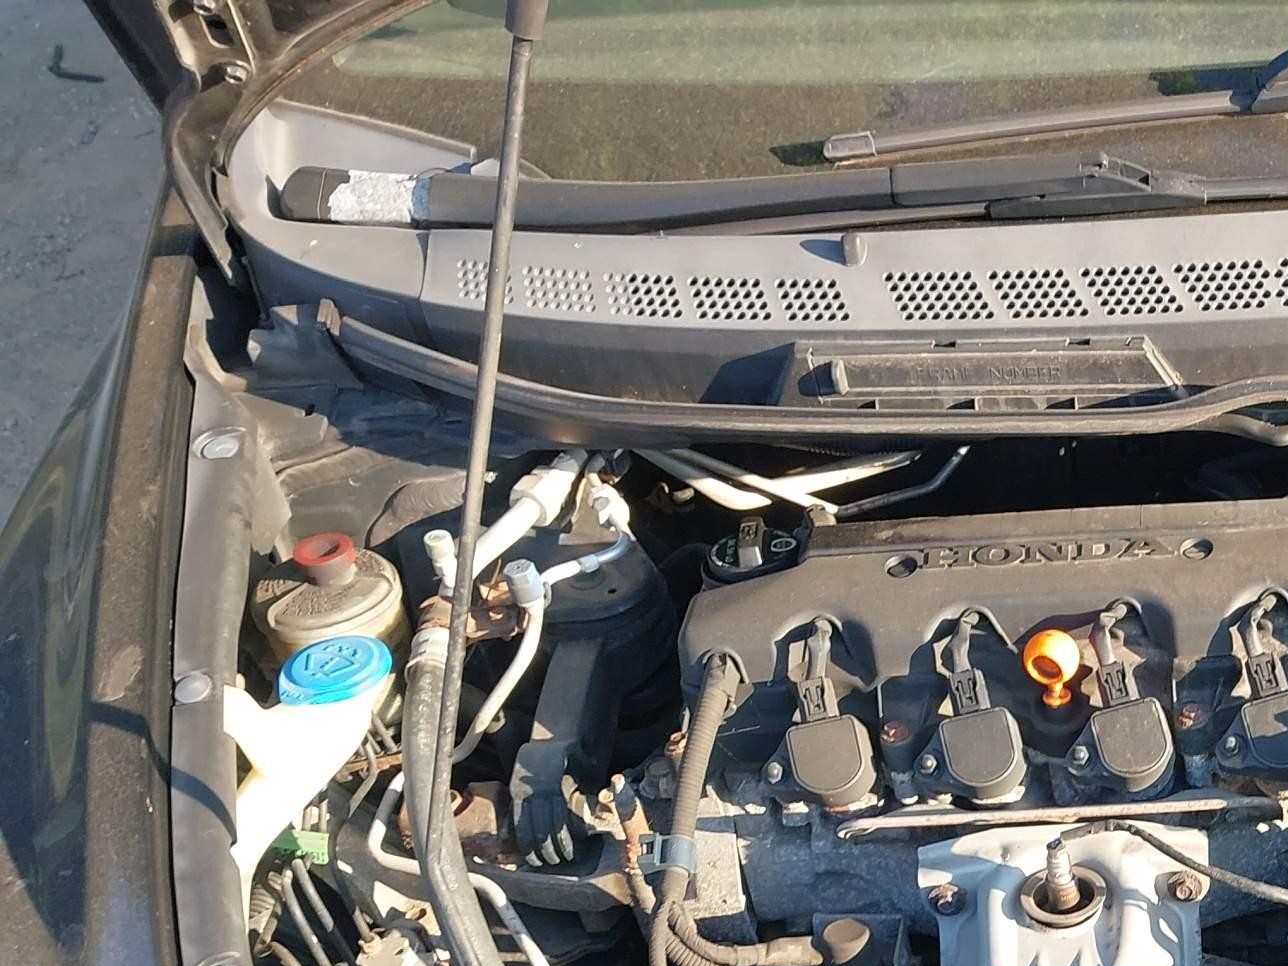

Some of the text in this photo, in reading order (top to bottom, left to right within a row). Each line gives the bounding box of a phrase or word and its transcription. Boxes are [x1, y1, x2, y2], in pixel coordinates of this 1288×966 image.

[916, 365, 1062, 383] FRAME NUMBER
[919, 537, 1175, 570] HONDA
